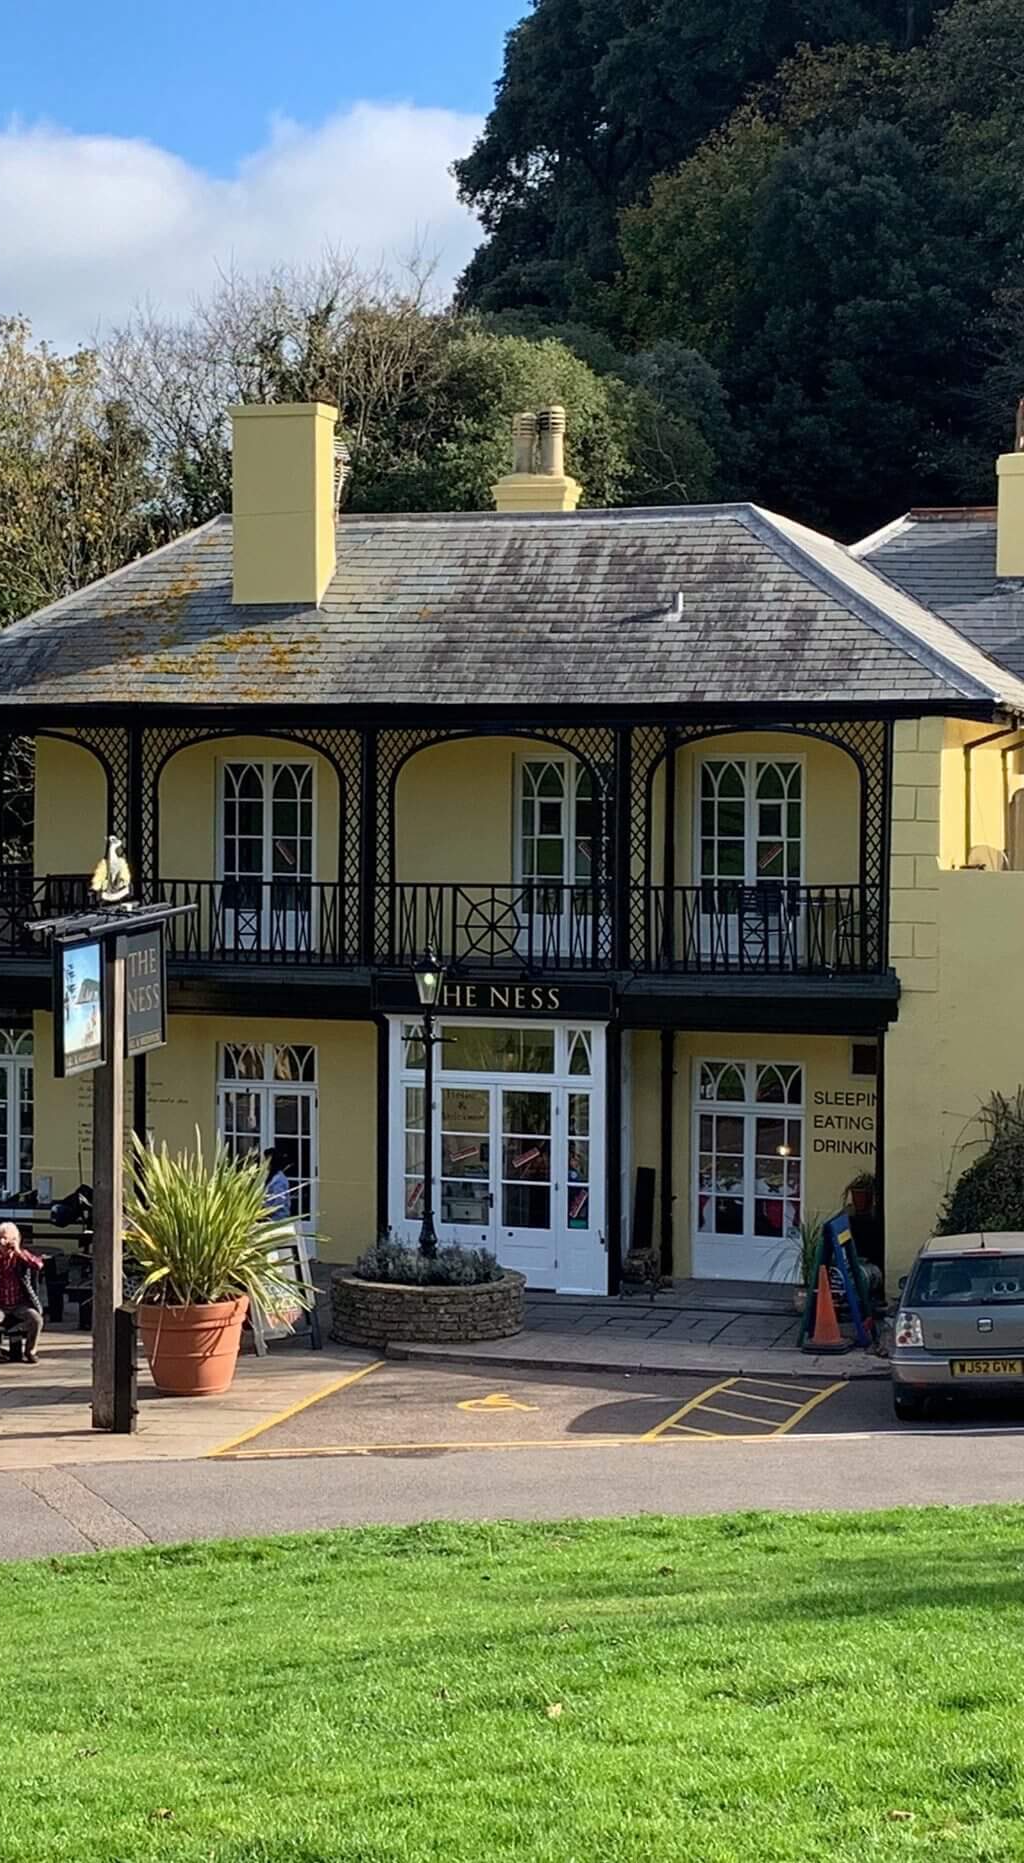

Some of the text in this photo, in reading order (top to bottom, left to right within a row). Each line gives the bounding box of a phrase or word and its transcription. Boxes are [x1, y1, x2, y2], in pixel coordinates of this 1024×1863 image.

[128, 948, 157, 978] THE
[128, 983, 160, 1015] NESS
[435, 984, 560, 1010] HE NESS
[813, 1115, 874, 1131] EATING
[813, 1139, 879, 1155] DRINKIN
[959, 1360, 990, 1374] WJ52
